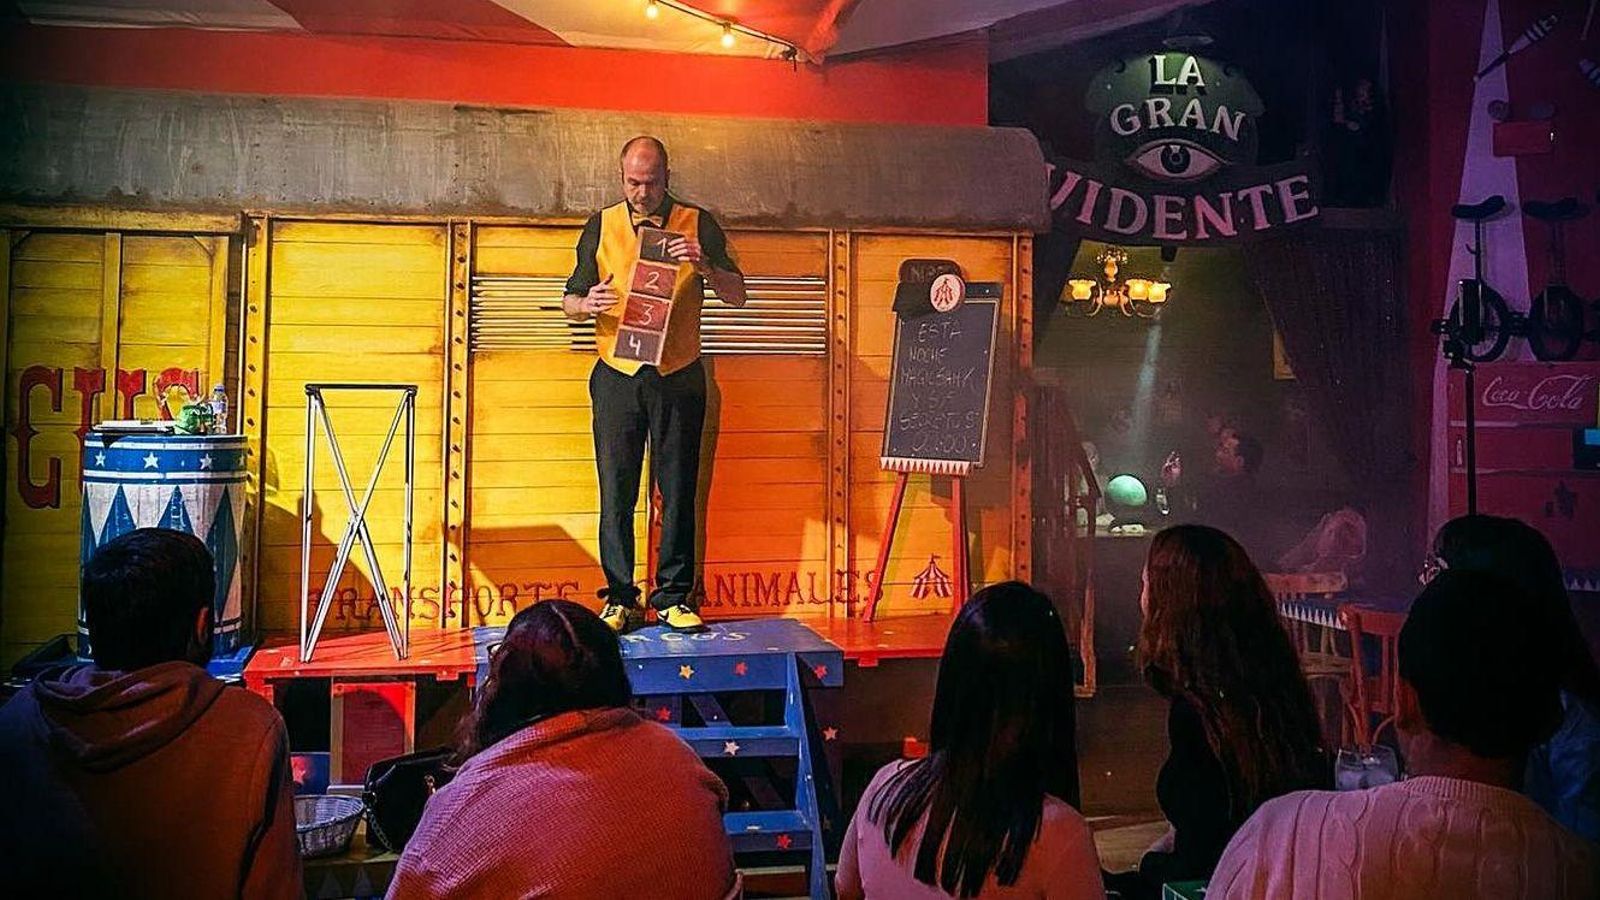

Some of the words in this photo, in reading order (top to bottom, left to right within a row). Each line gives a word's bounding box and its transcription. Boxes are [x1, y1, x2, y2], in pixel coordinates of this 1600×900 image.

[1153, 54, 1205, 87] LA
[1109, 98, 1246, 141] GRAN
[1045, 163, 1319, 240] VIDENTE
[656, 237, 668, 258] 1
[644, 271, 661, 290] 2
[638, 303, 655, 326] 3
[629, 333, 642, 357] 4
[1482, 374, 1597, 410] Coca-Cola
